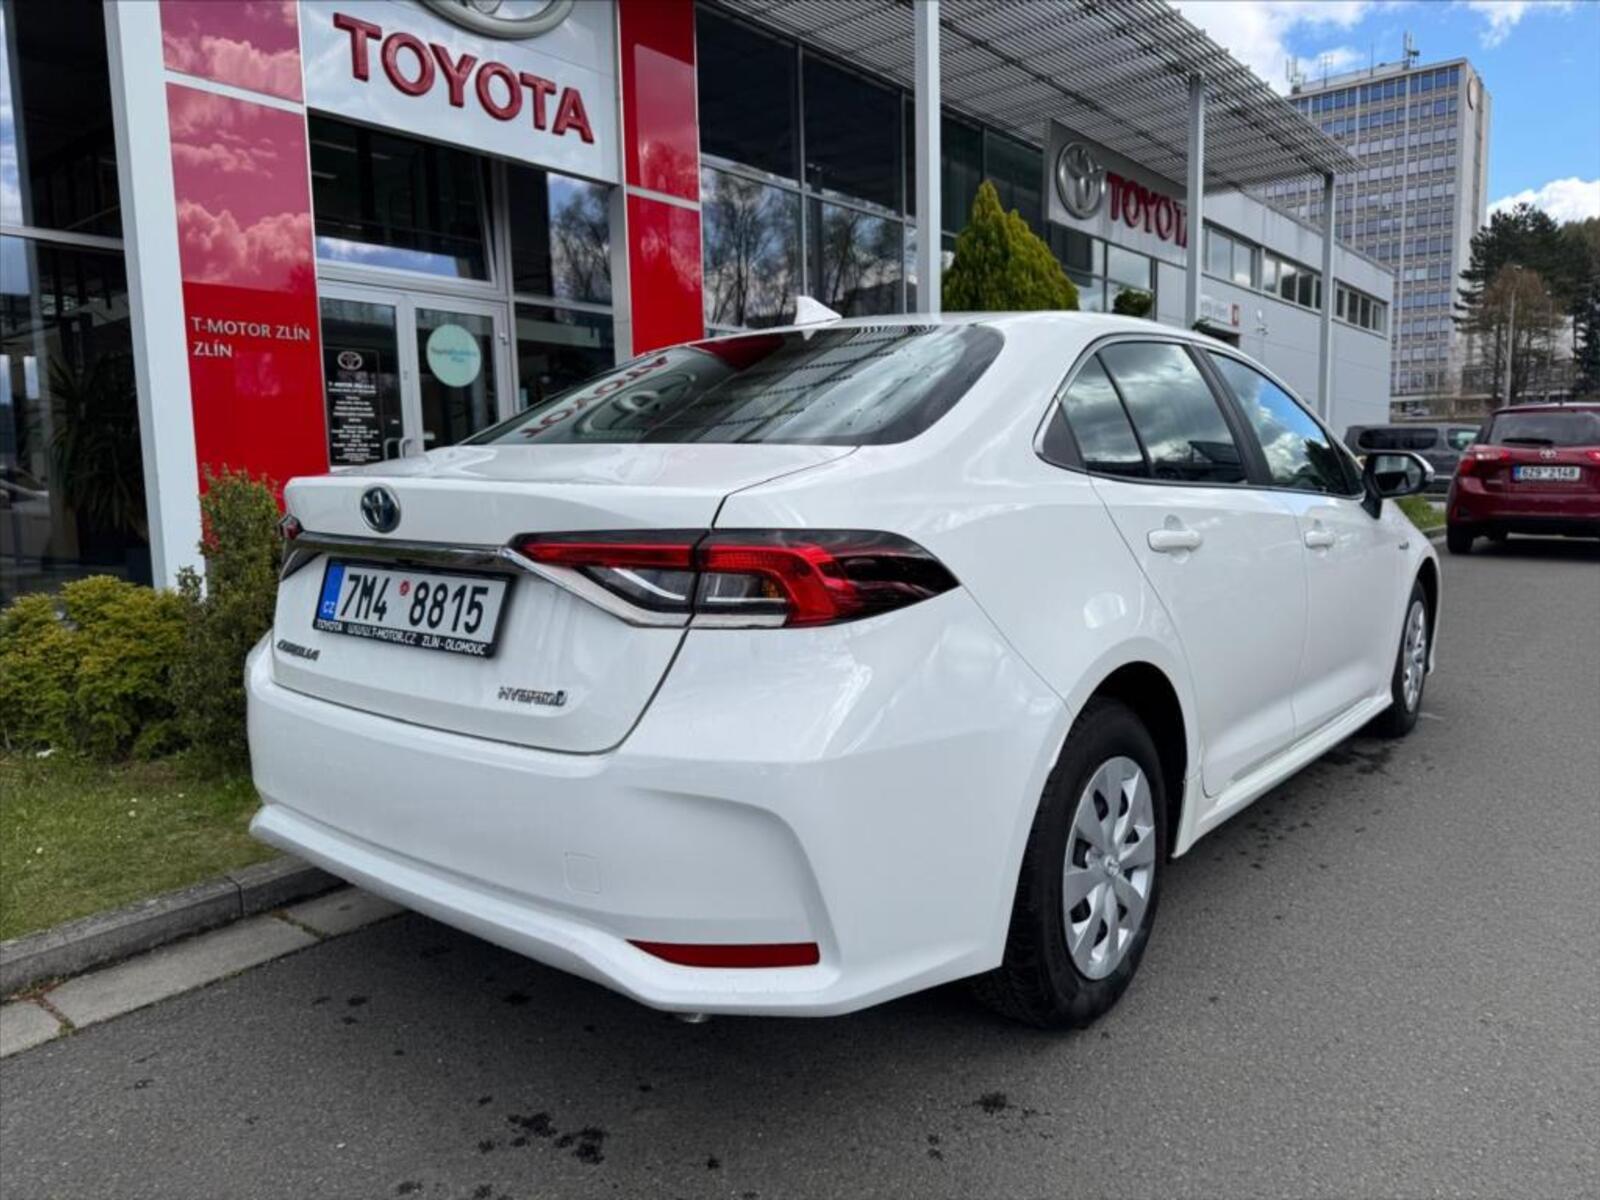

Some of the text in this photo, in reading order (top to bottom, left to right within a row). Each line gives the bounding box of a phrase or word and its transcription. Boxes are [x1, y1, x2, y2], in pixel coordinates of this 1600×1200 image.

[333, 12, 594, 144] TOYOTA
[191, 316, 310, 341] T-MOTOR ZLÍN
[193, 340, 232, 358] ZLÍN
[322, 601, 335, 614] CZ
[341, 574, 489, 634] 7M4 8815
